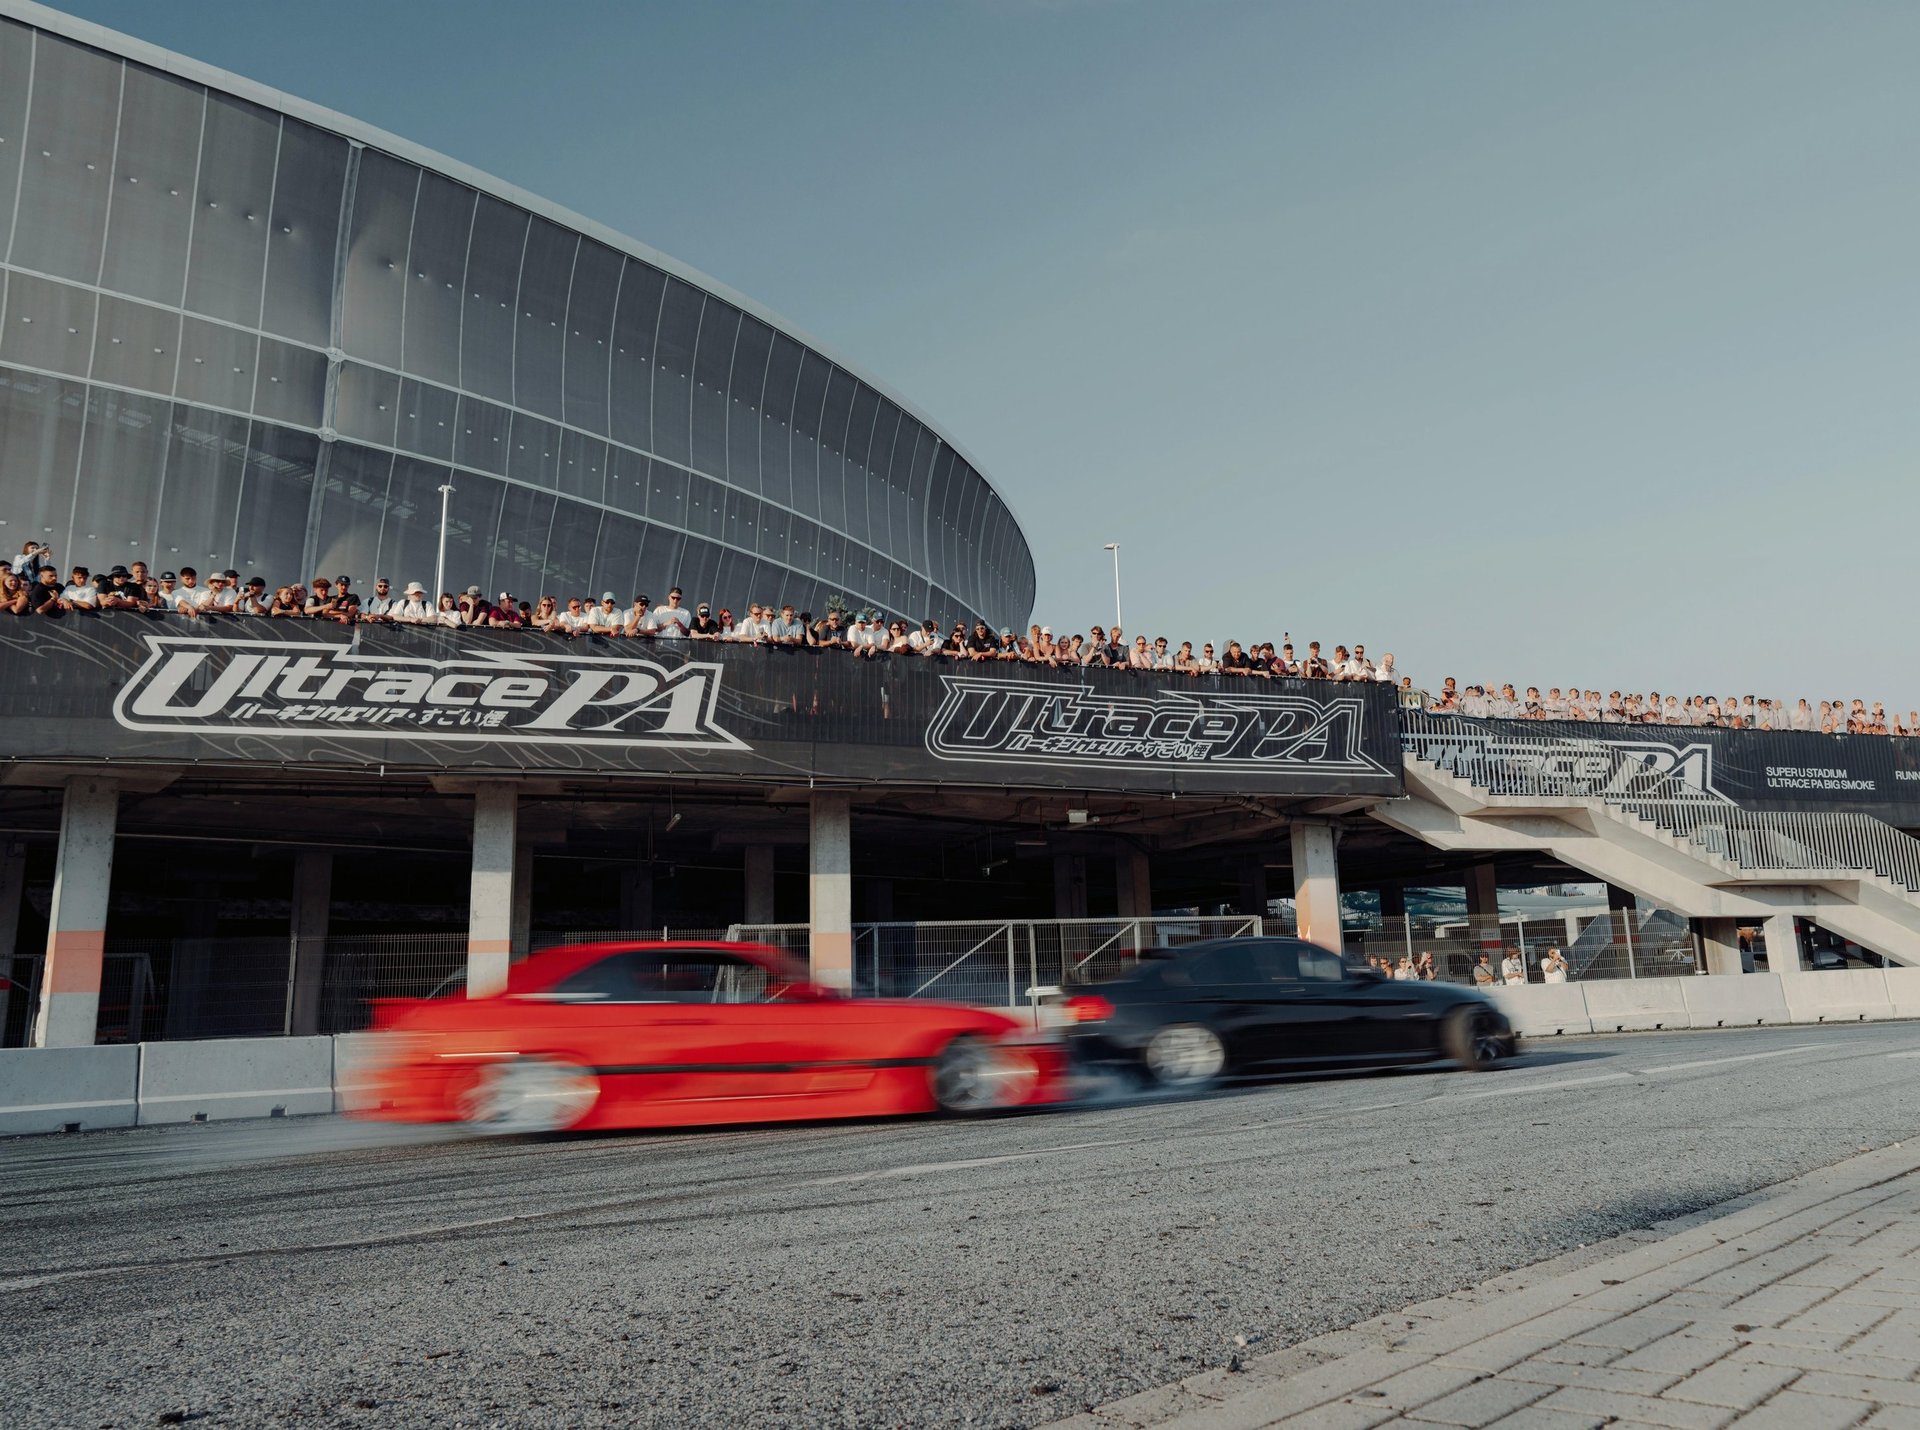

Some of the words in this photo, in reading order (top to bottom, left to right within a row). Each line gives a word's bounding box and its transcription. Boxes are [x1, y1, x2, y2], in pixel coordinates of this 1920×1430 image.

[132, 652, 549, 718] Ultrace
[510, 669, 709, 735] PA
[1210, 707, 1353, 763] PA
[1766, 767, 1798, 777] SUPER
[1806, 768, 1847, 779] STADIUM
[1767, 778, 1811, 789] ULTRACE
[1811, 779, 1824, 789] PA
[1824, 780, 1841, 790] BIG
[1841, 780, 1876, 791] SMOKE
